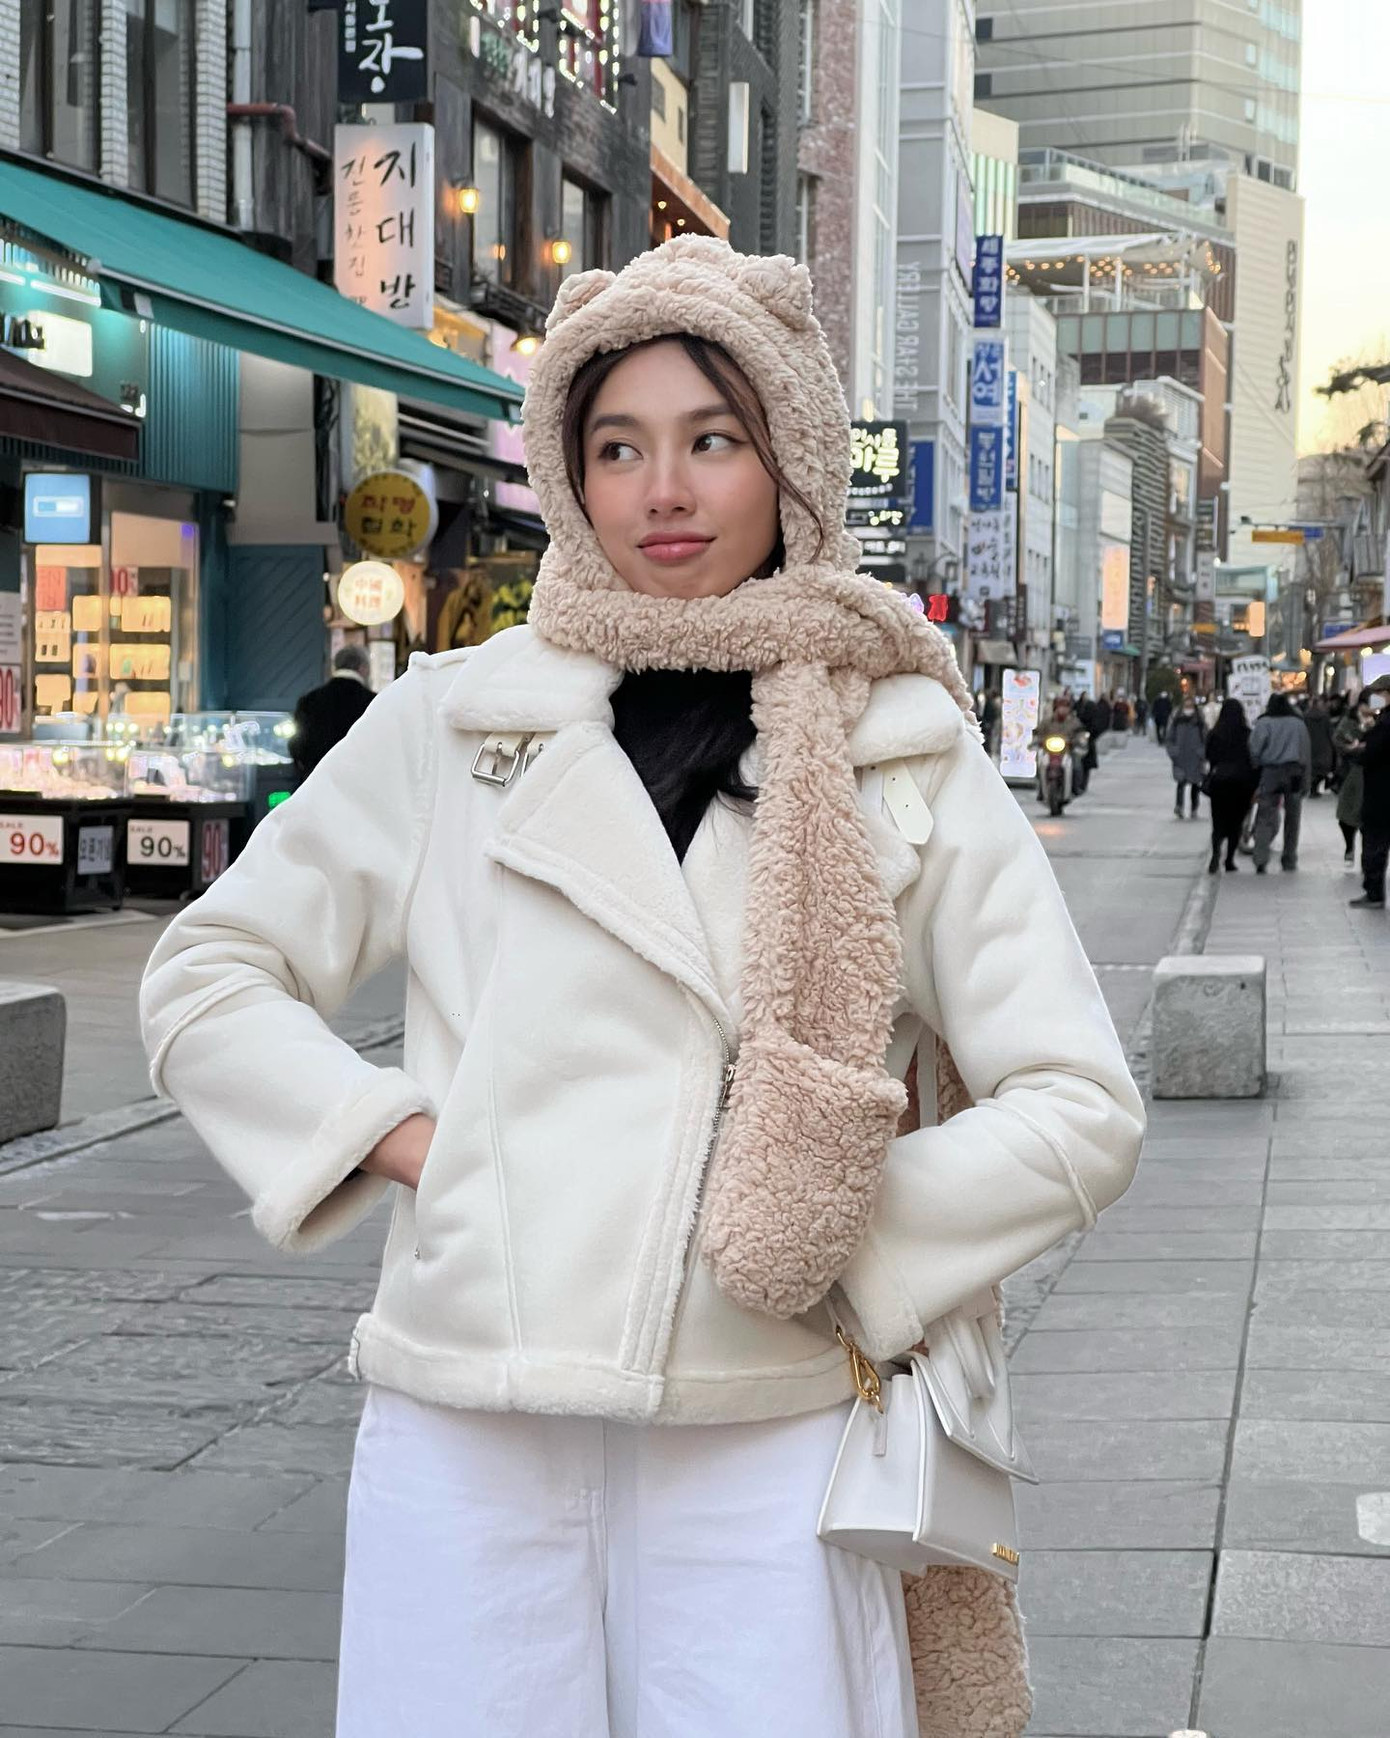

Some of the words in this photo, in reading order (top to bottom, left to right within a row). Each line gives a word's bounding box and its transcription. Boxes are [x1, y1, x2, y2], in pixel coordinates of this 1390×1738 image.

[374, 141, 416, 309] 지대방
[10, 833, 59, 856] 90%
[140, 836, 185, 858] 90%
